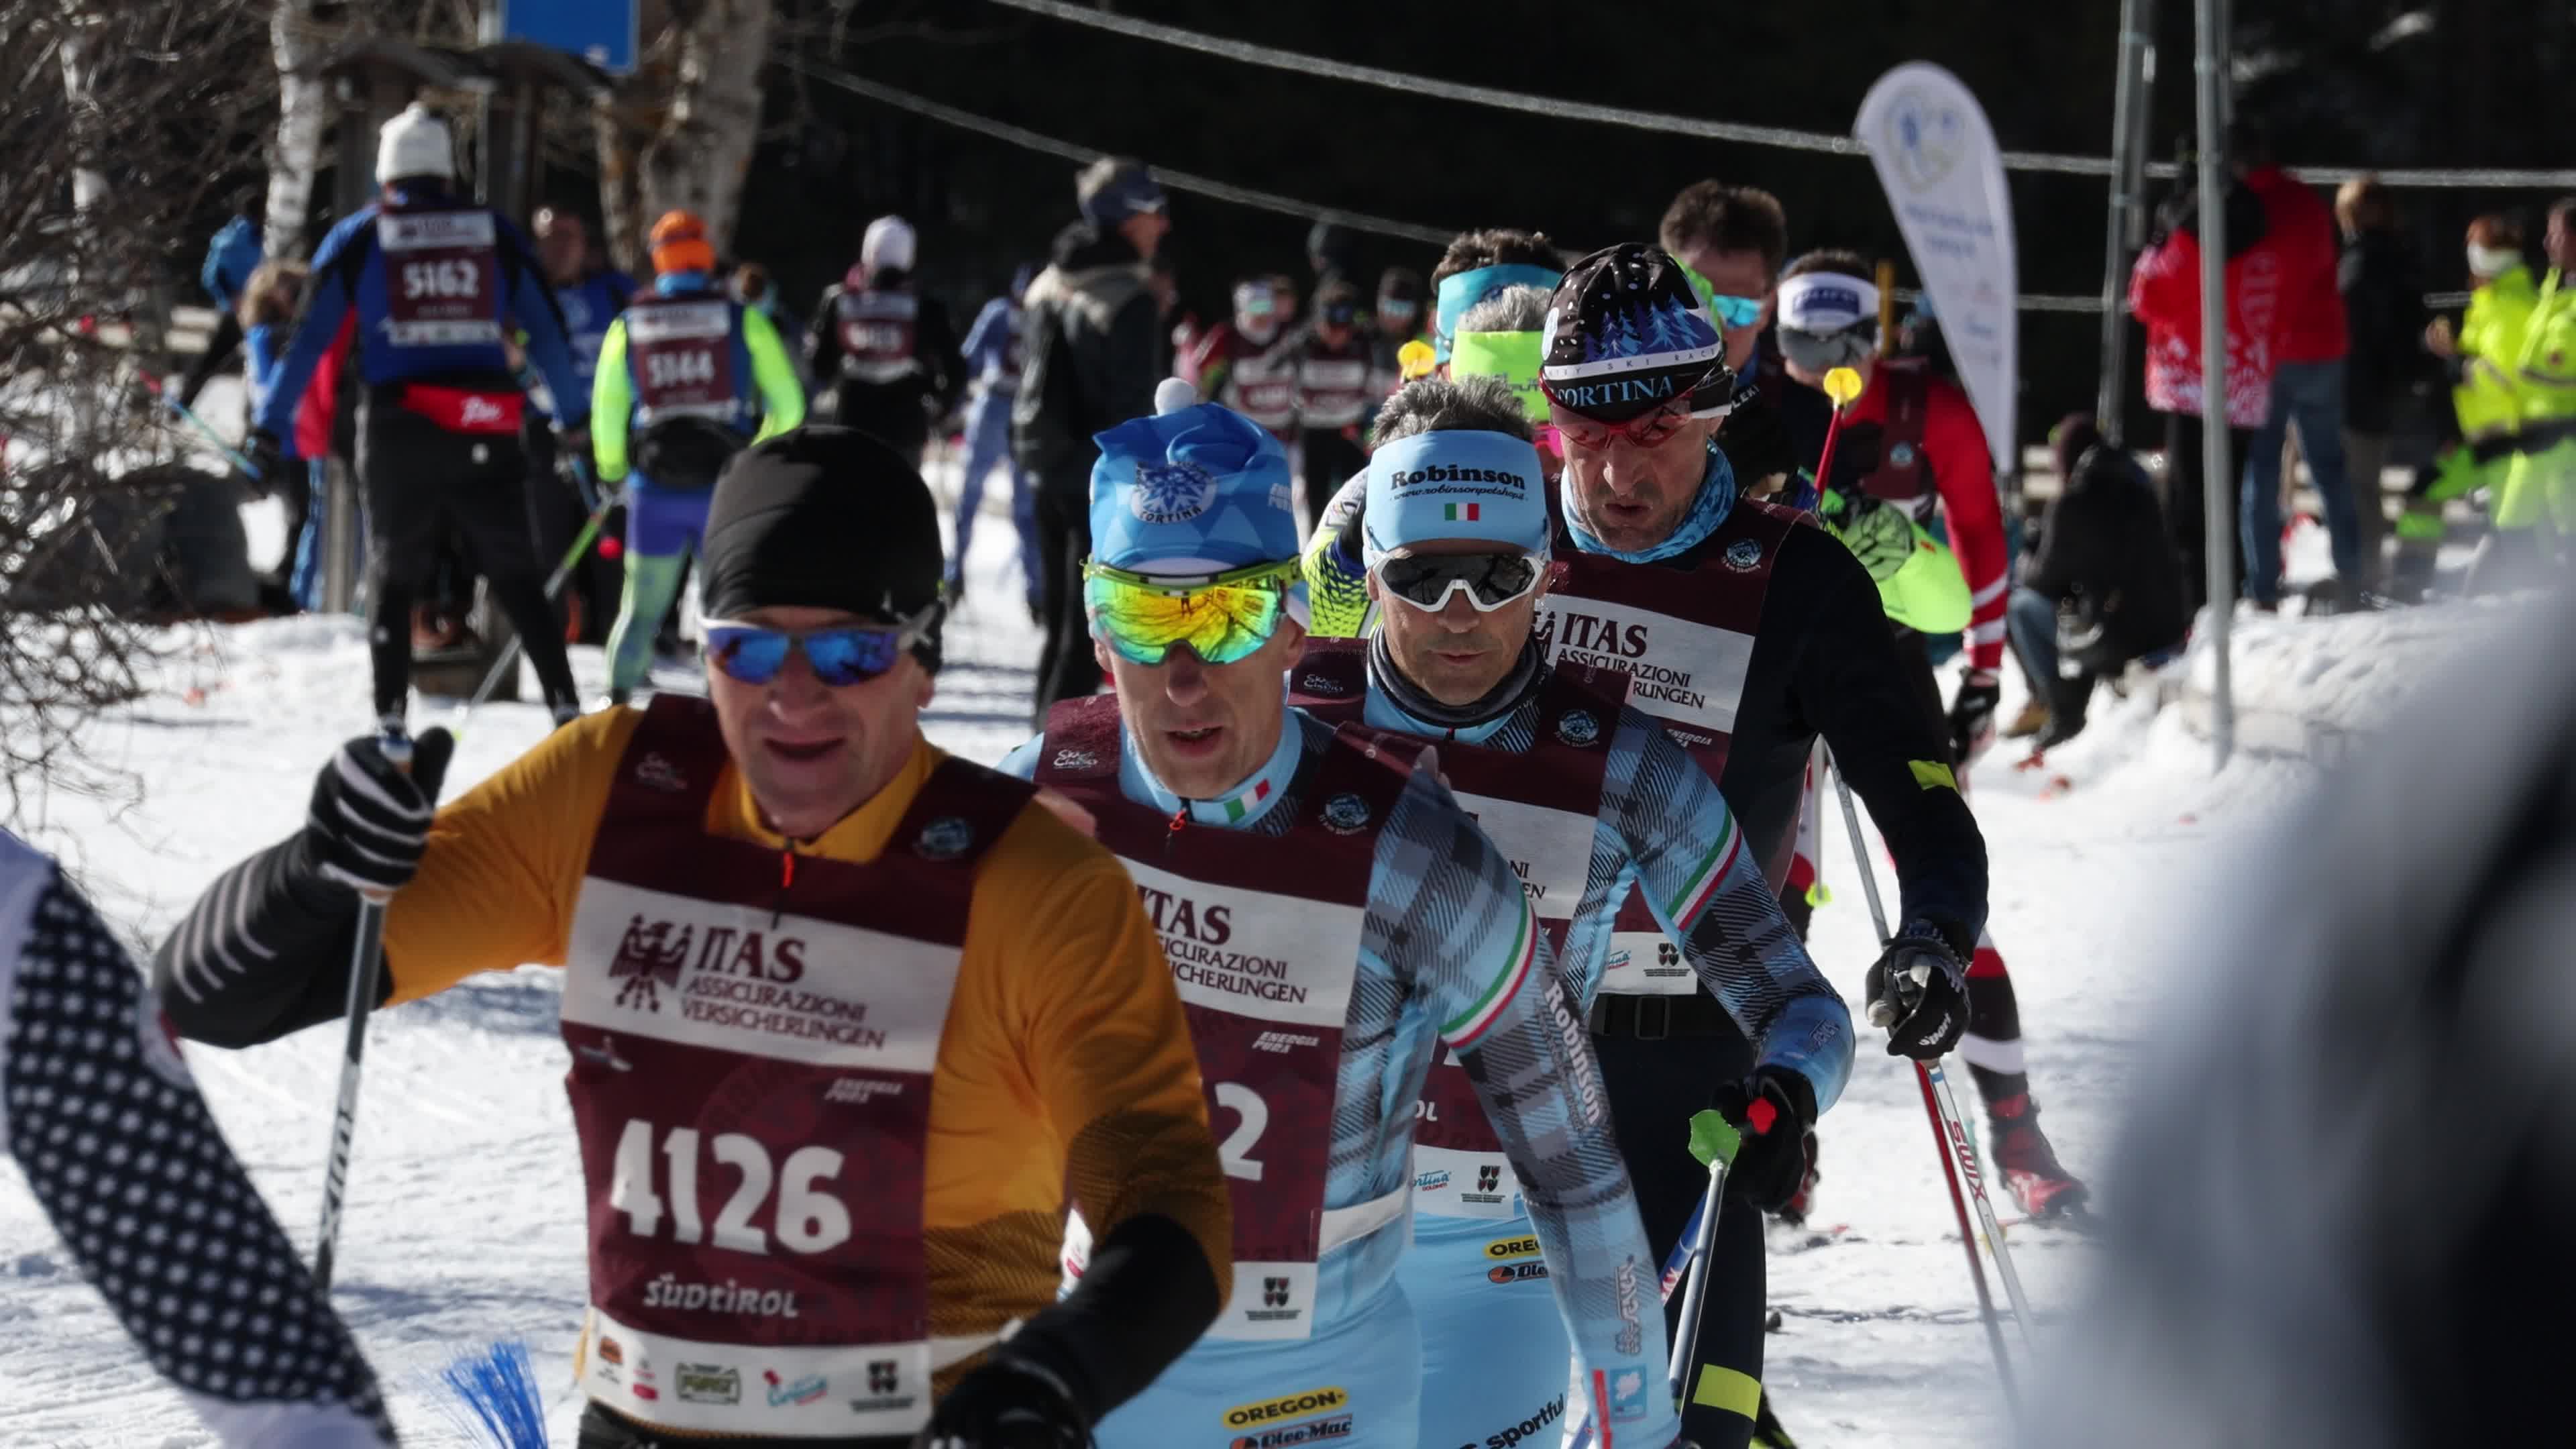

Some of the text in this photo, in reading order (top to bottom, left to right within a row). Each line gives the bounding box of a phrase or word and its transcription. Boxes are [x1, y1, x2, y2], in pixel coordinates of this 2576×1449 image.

[404, 259, 478, 299] 5162
[1391, 464, 1527, 490] Robinson
[1560, 612, 1649, 658] ITAS
[1558, 647, 1691, 688] ASSICURAZIONI
[695, 926, 806, 984] ITAS
[1159, 936, 1288, 979] ICURAZIONI
[684, 975, 867, 1022] ASSICURAZIONI
[681, 996, 888, 1051] VERSICHERUNGEN
[1545, 979, 1600, 1125] Robinson
[1952, 1120, 1986, 1202] SWIX
[610, 1118, 851, 1255] 4126
[1229, 1391, 1337, 1426] OREGON
[1486, 1393, 1564, 1449] sportful
